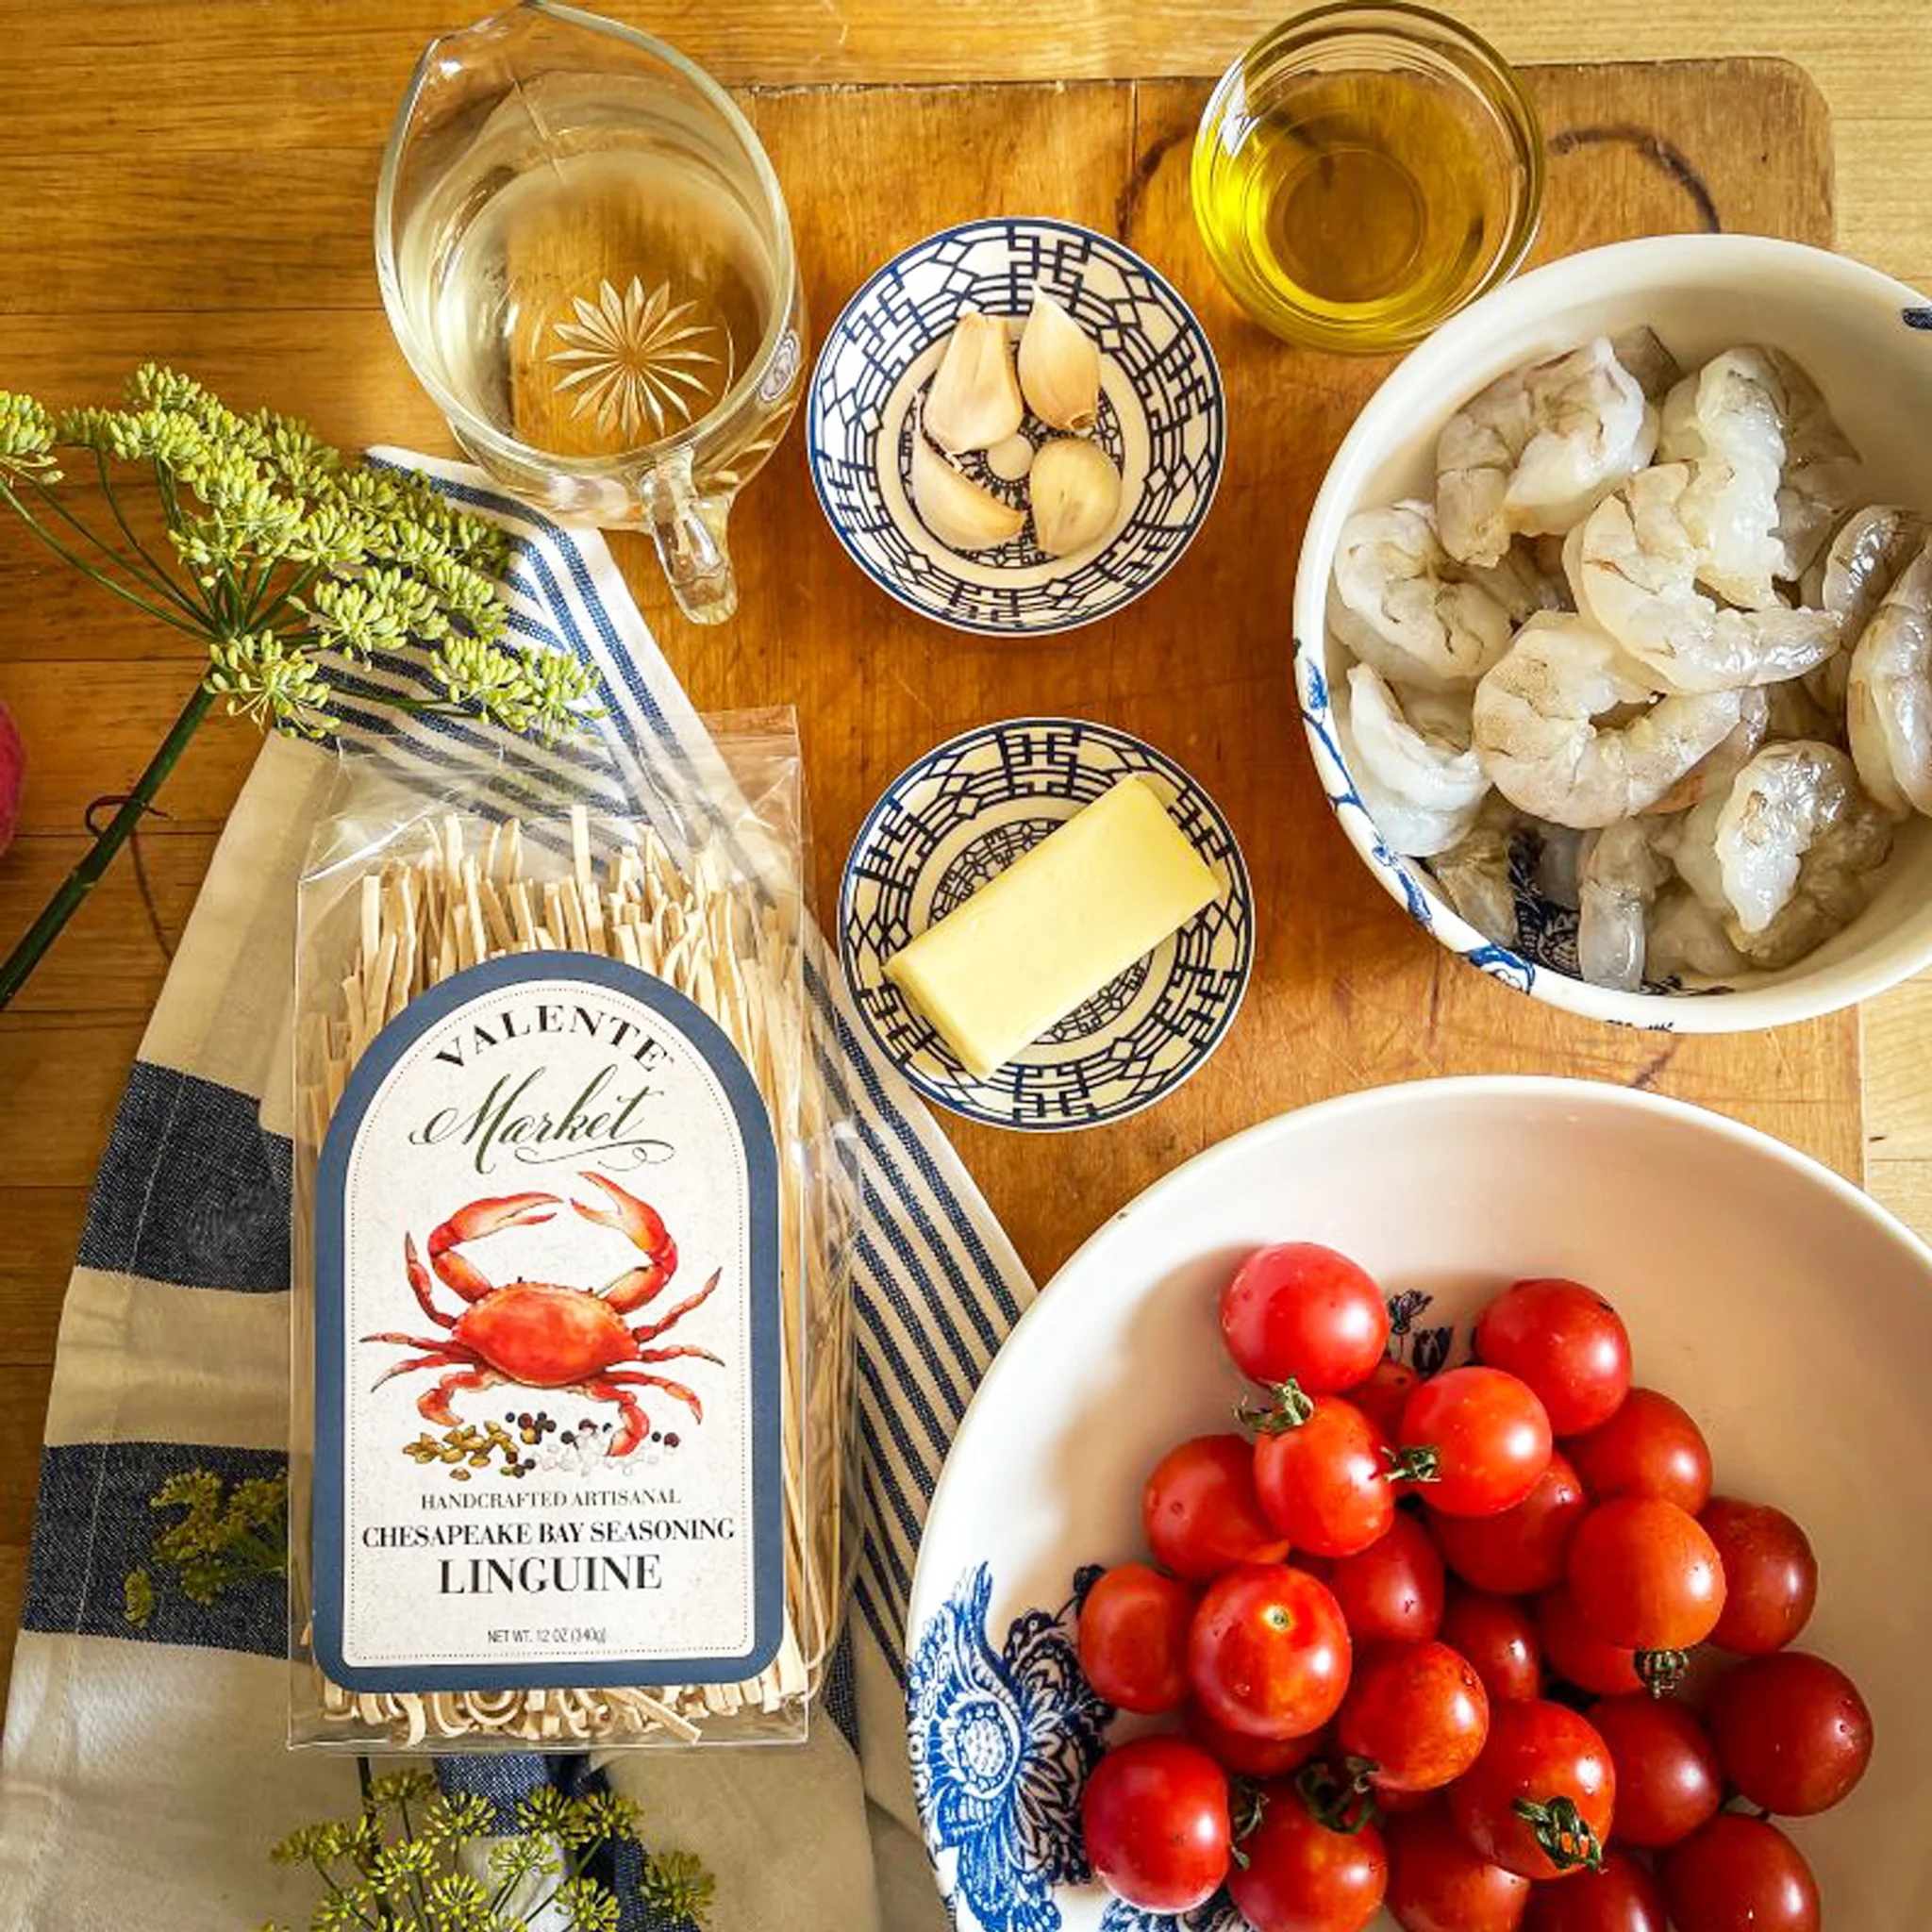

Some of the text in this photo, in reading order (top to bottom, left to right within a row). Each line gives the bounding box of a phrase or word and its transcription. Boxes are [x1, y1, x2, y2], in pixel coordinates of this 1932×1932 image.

[433, 1005, 667, 1072] VALENTE
[408, 1064, 675, 1174] Market
[421, 1489, 682, 1509] HANDCRAFTED ARTISANAL
[362, 1517, 735, 1547] CHESAPEAKE BAY SEASONING
[437, 1554, 662, 1594] LINGUINE
[487, 1628, 509, 1643] NET
[511, 1628, 533, 1643] WT.
[536, 1627, 550, 1643] 12
[552, 1626, 568, 1643] OZ
